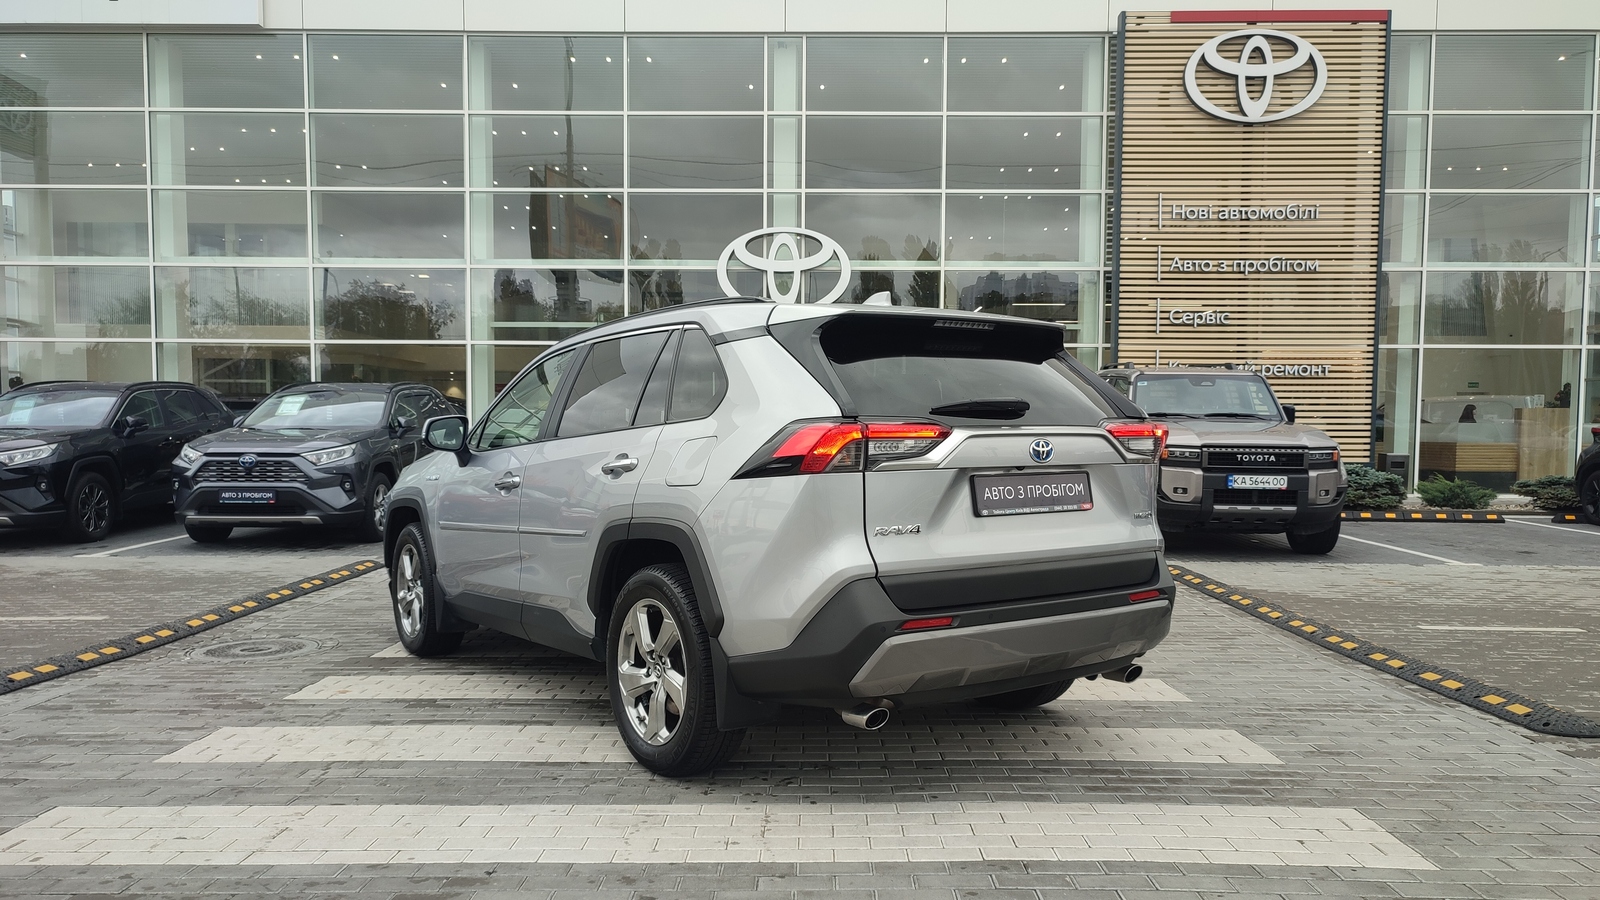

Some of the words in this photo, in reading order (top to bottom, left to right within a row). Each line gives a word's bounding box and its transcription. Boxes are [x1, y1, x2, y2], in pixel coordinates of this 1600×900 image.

[1172, 204, 1212, 219] Нові
[1218, 203, 1320, 219] автомобілі
[1170, 256, 1213, 272] Авто
[1217, 260, 1227, 272] з
[1233, 255, 1319, 276] пробігом
[1169, 308, 1231, 327] Сервіс
[1262, 363, 1331, 377] ремонт
[1236, 454, 1276, 462] TOYOTA
[1233, 476, 1247, 486] KA
[1249, 476, 1271, 486] 5644
[983, 486, 1015, 500] АВТО
[1017, 485, 1025, 499] З
[1027, 482, 1085, 498] ПРОБІГОМ
[873, 523, 921, 537] RAV4
